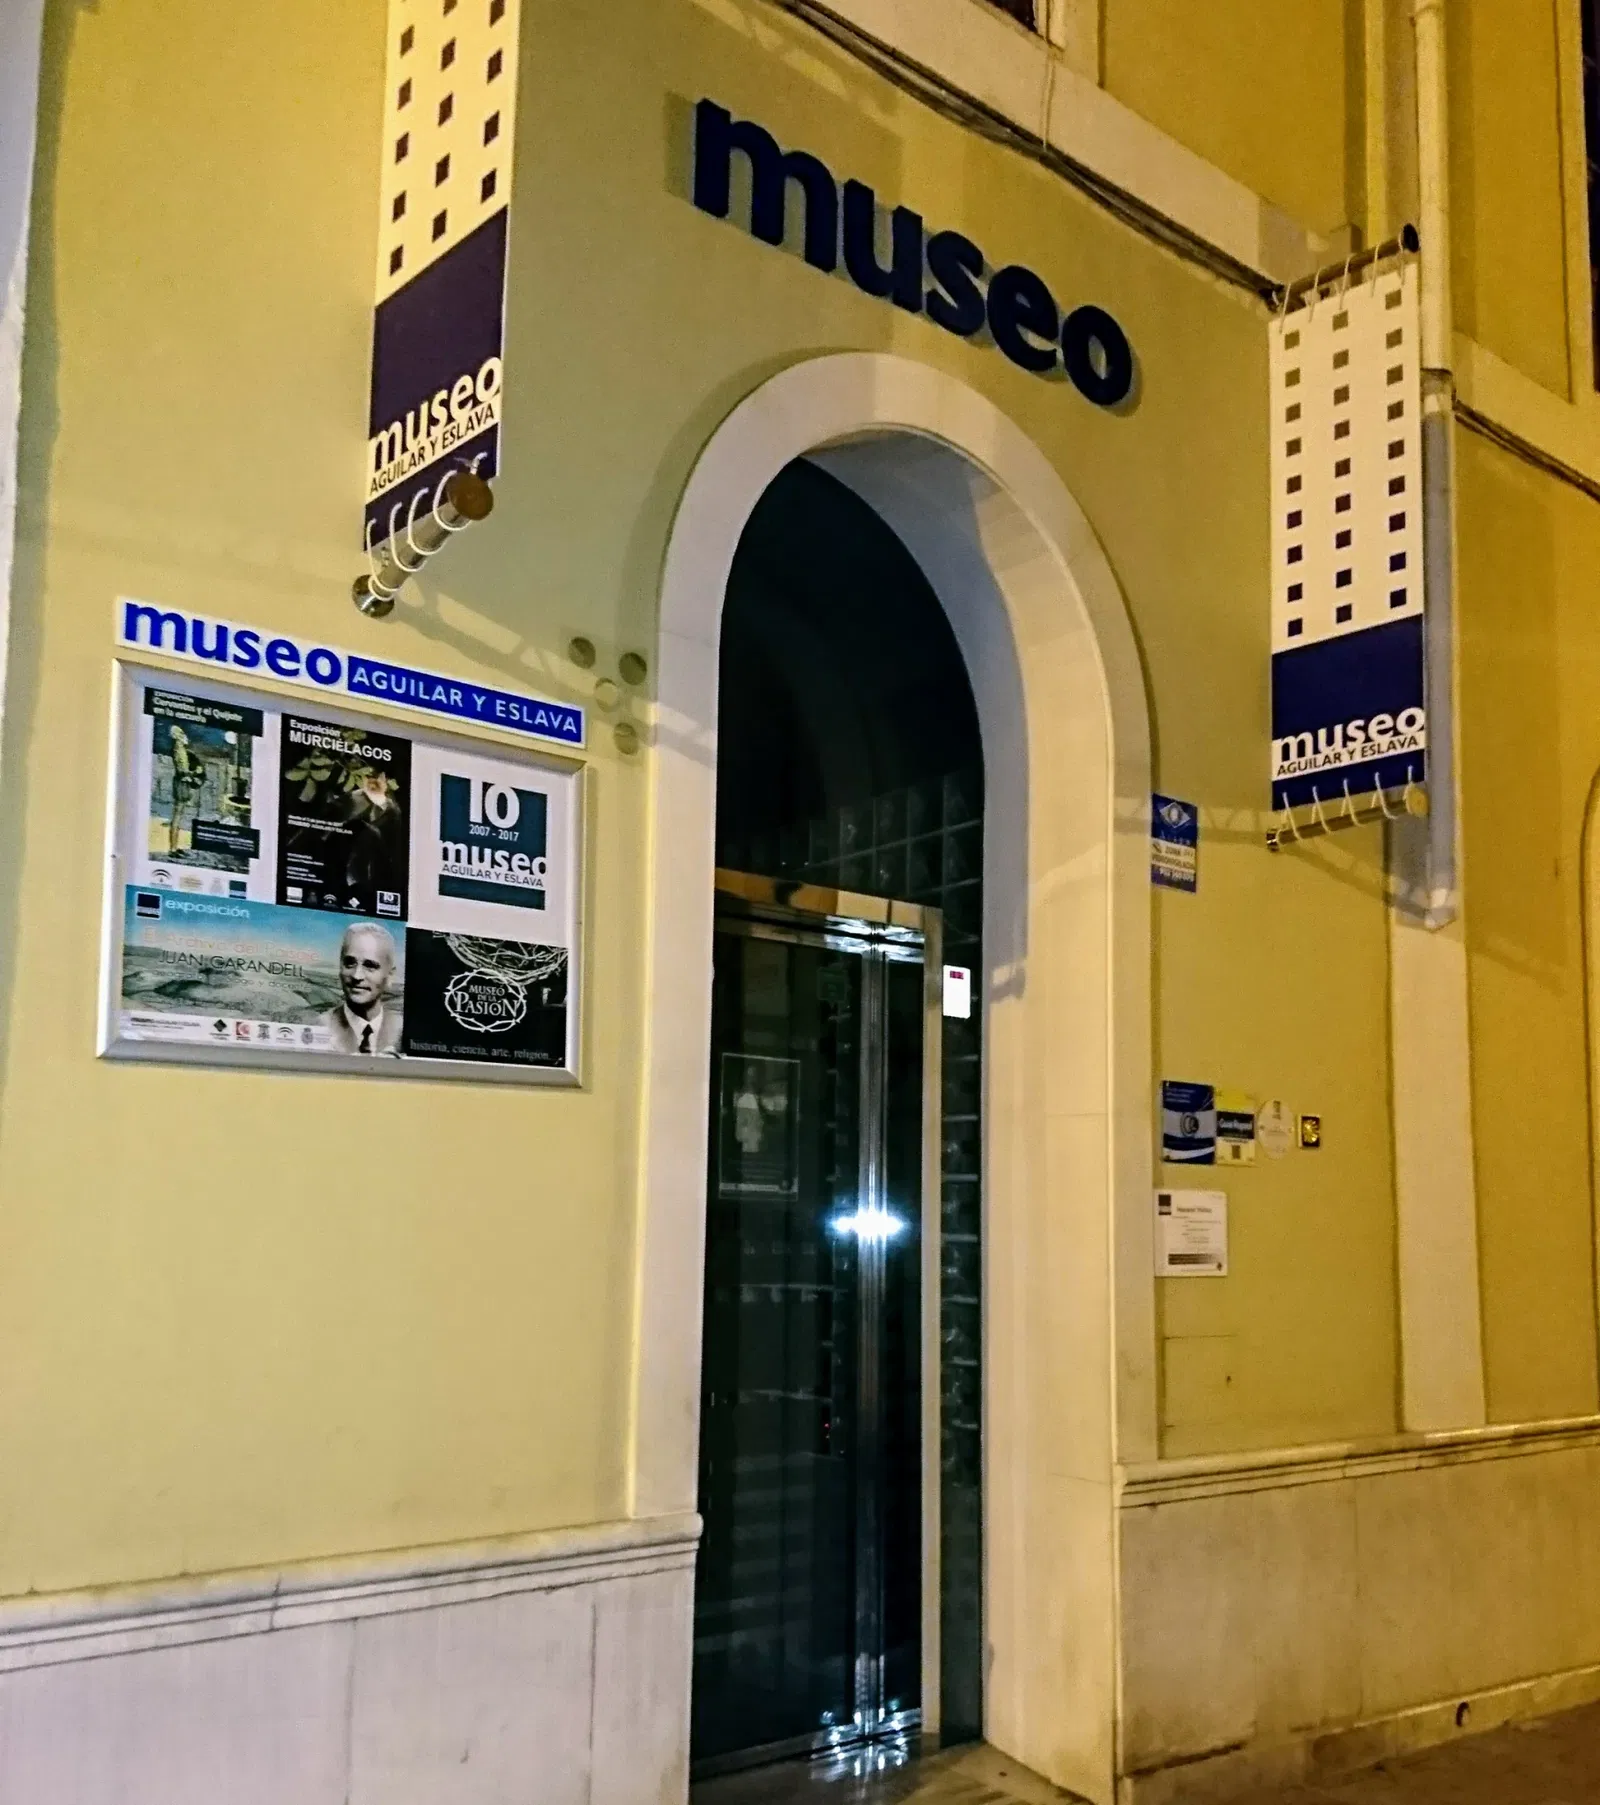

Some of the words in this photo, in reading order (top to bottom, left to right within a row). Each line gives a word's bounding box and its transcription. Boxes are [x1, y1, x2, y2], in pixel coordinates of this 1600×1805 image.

[693, 98, 1132, 406] museo
[368, 357, 502, 476] museo
[370, 446, 425, 495] AGUILAR
[430, 437, 438, 457] Y
[442, 402, 495, 450] ESLAVA
[125, 602, 341, 685] museo
[352, 667, 463, 707] AGUILAR
[472, 693, 487, 712] Y
[496, 700, 577, 734] ESLAVA
[290, 719, 341, 737] Exposición
[1272, 707, 1425, 761] museo
[289, 730, 392, 761] MURCIÉLAGOS
[1277, 752, 1341, 776] AGUILAR
[1345, 748, 1356, 761] Y
[1361, 736, 1418, 757] ESLAVA
[469, 824, 490, 837] 2007
[498, 829, 519, 842] 2017
[440, 840, 547, 875] museo
[442, 864, 491, 879] AGUILAR
[494, 871, 502, 881] Y
[504, 873, 543, 887] ESLAVA
[165, 899, 250, 918] exposición
[159, 950, 203, 966] JUAN
[455, 991, 518, 1017] PASIÓN
